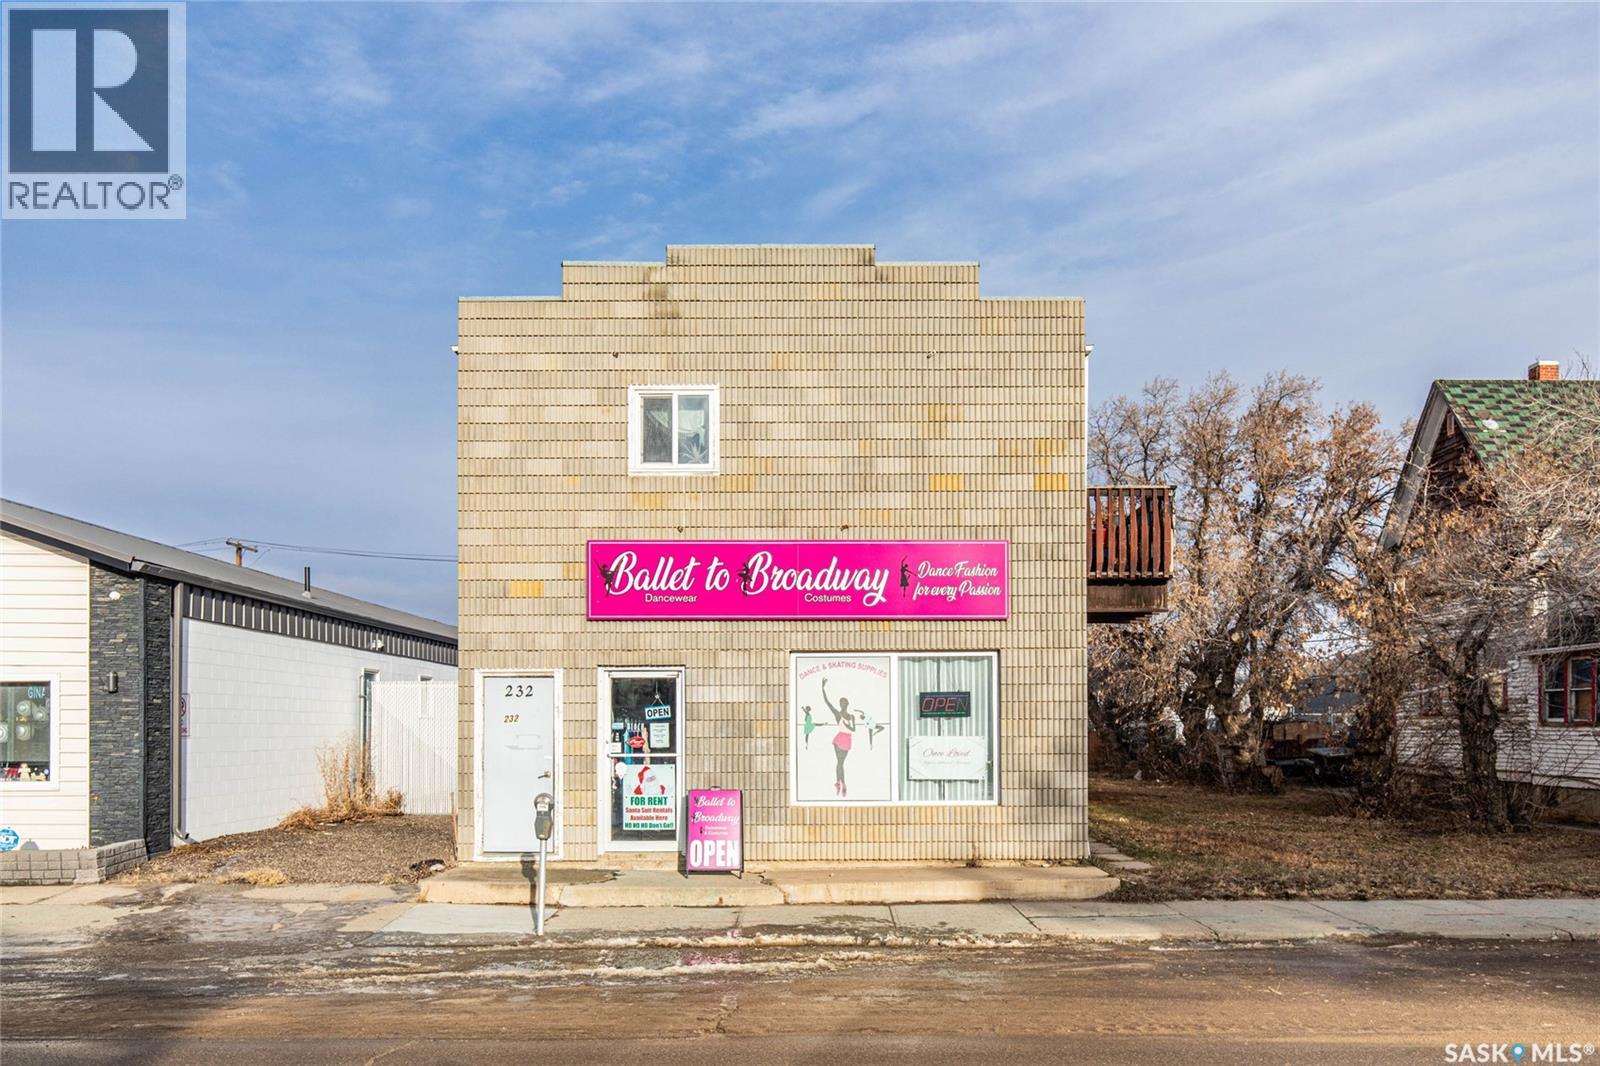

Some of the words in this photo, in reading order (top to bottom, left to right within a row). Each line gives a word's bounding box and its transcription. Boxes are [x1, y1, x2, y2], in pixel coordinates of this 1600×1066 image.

[918, 560, 953, 579] Dance
[954, 560, 998, 577] Fashion
[605, 550, 701, 596] Ballet
[705, 556, 730, 591] to
[740, 550, 890, 607] Broadway
[912, 582, 930, 601] for
[931, 585, 957, 602] every
[959, 579, 1001, 597] Passion
[644, 593, 697, 603] Dancewear
[804, 593, 852, 603] Costumes
[800, 665, 821, 680] DANCE
[828, 661, 857, 669] SKATING
[857, 663, 888, 678] SUPPLIES
[504, 684, 534, 697] 232
[921, 697, 969, 712] OPEN
[503, 713, 520, 723] 232
[646, 707, 670, 718] OPEN
[630, 796, 646, 806] FOR
[647, 796, 668, 806] RENT
[696, 795, 725, 808] Ballet
[727, 797, 737, 807] to
[692, 811, 741, 825] Broadway
[689, 839, 740, 868] OPEN
